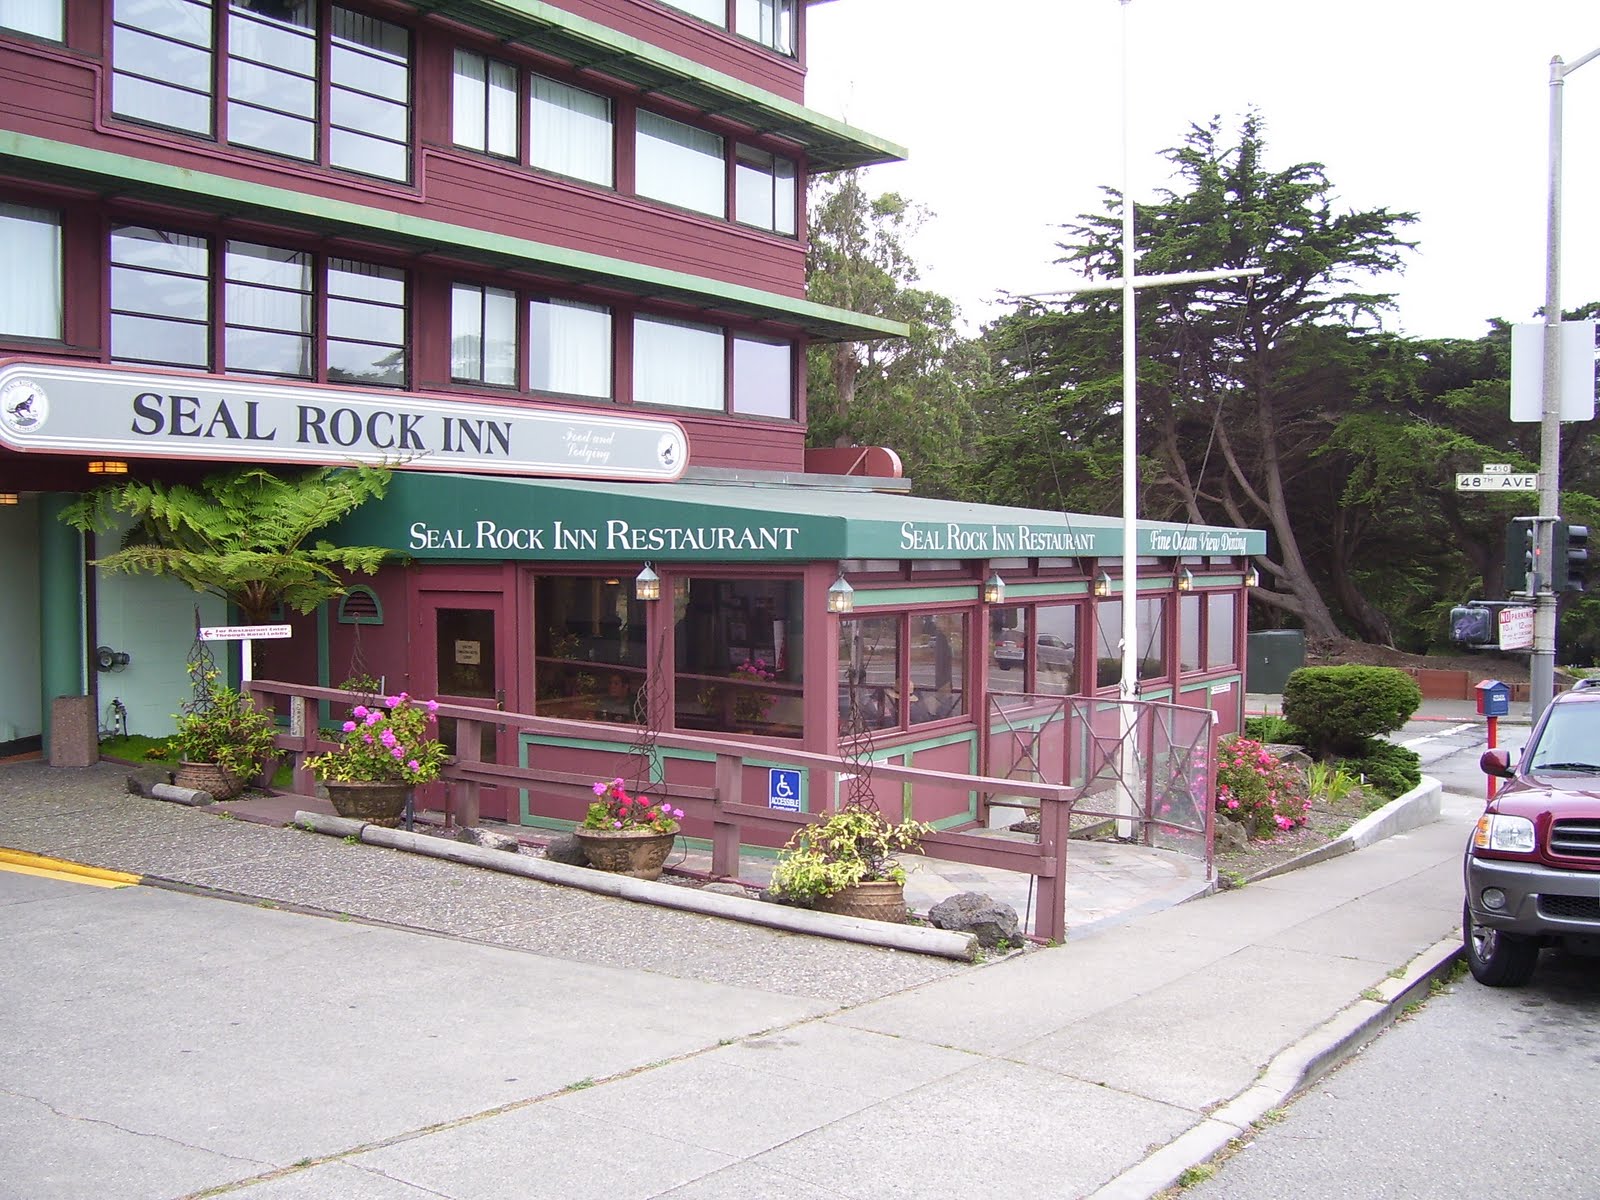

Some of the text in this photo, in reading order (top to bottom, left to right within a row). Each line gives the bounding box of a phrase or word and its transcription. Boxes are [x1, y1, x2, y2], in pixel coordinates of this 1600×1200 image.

[130, 392, 513, 456] SEAL ROCK INN
[562, 427, 616, 445] Food and
[567, 443, 611, 464] Lodging
[1460, 477, 1533, 487] 48TH AVE
[409, 519, 800, 550] SEAL ROCK INN RESTAURANT
[900, 521, 1096, 551] SEAL ROCK INN RESTAURANT
[1150, 529, 1247, 555] Fine Ocean View Dining
[1500, 610, 1533, 623] NO PARKING
